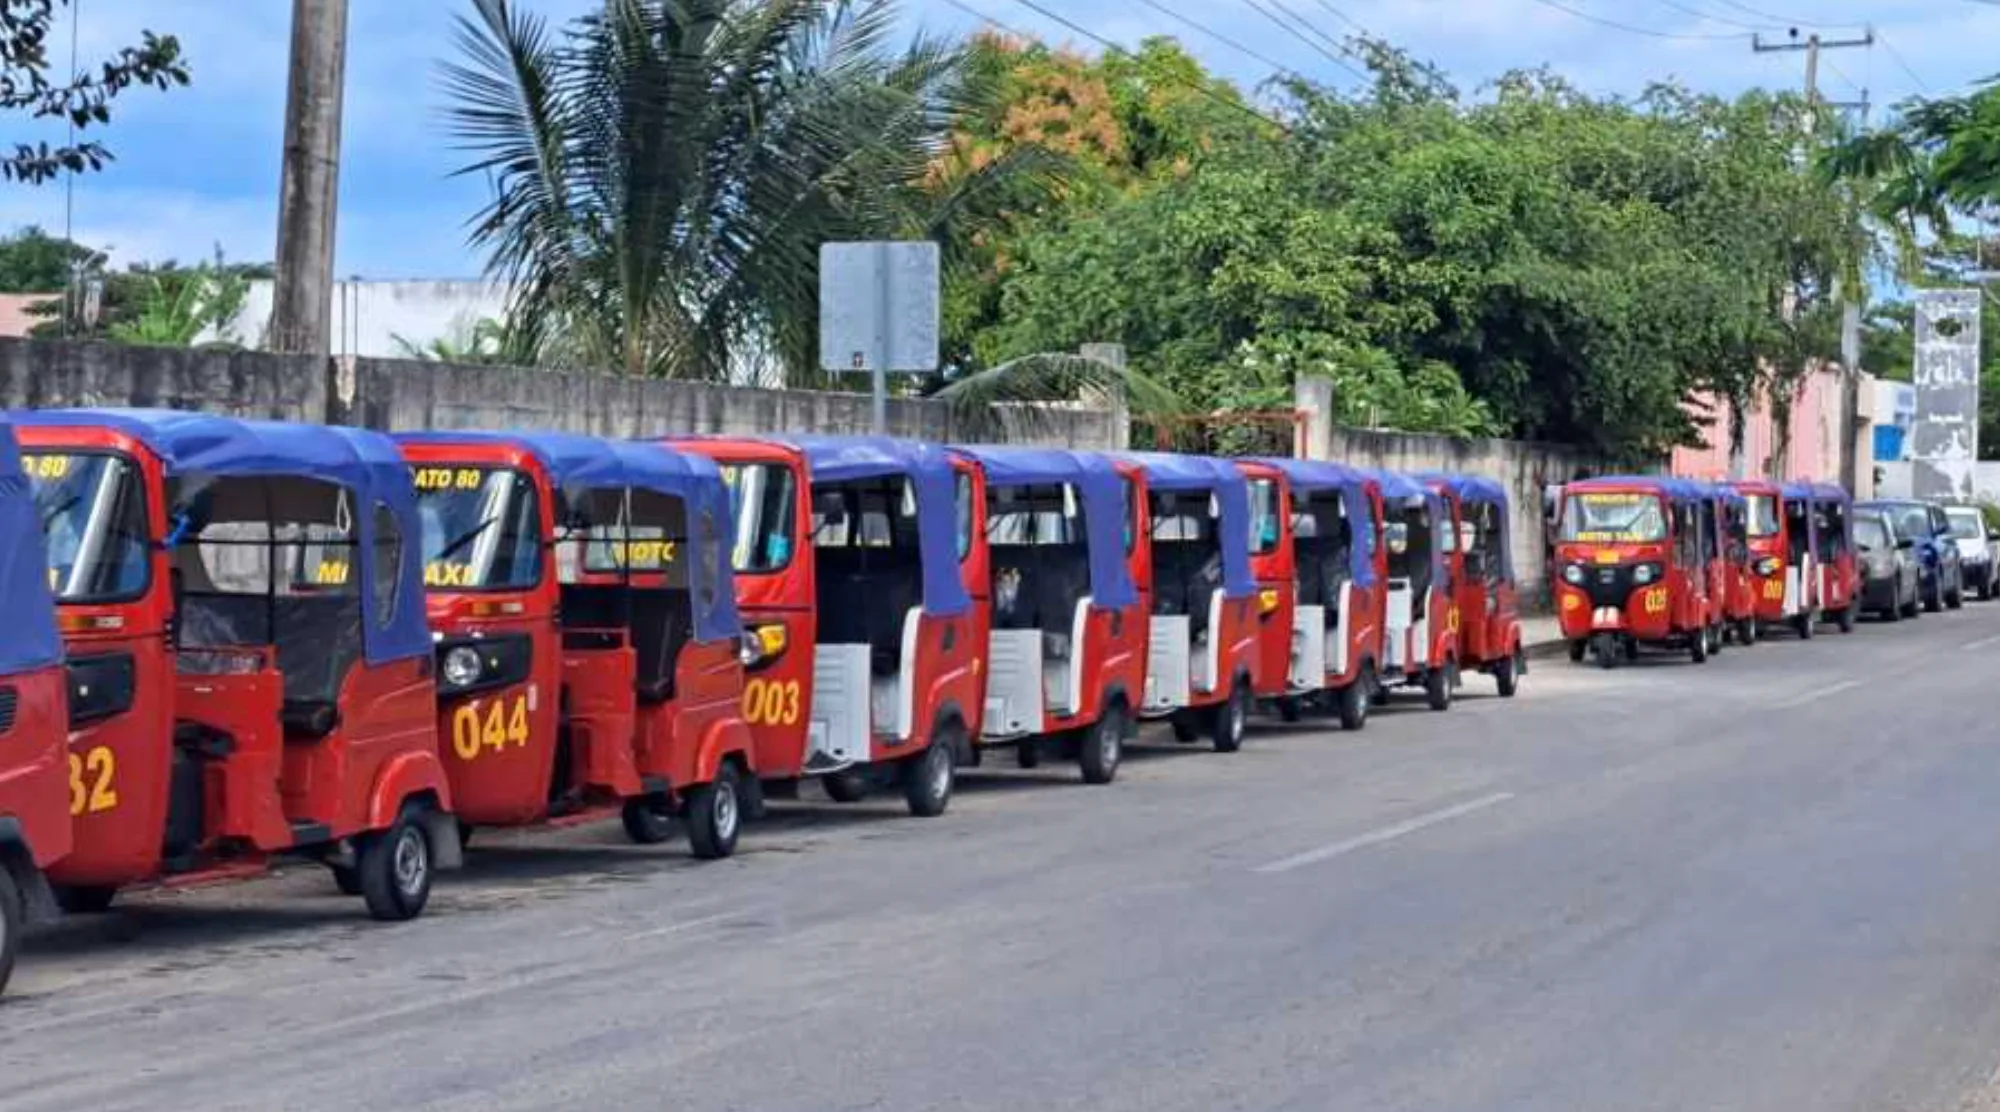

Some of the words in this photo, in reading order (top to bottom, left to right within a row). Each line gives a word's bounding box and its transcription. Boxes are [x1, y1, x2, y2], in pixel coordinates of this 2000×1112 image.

[38, 456, 68, 477] 80
[415, 468, 452, 488] ATO
[456, 468, 481, 488] 80
[743, 678, 799, 726] 003
[452, 695, 529, 760] 044
